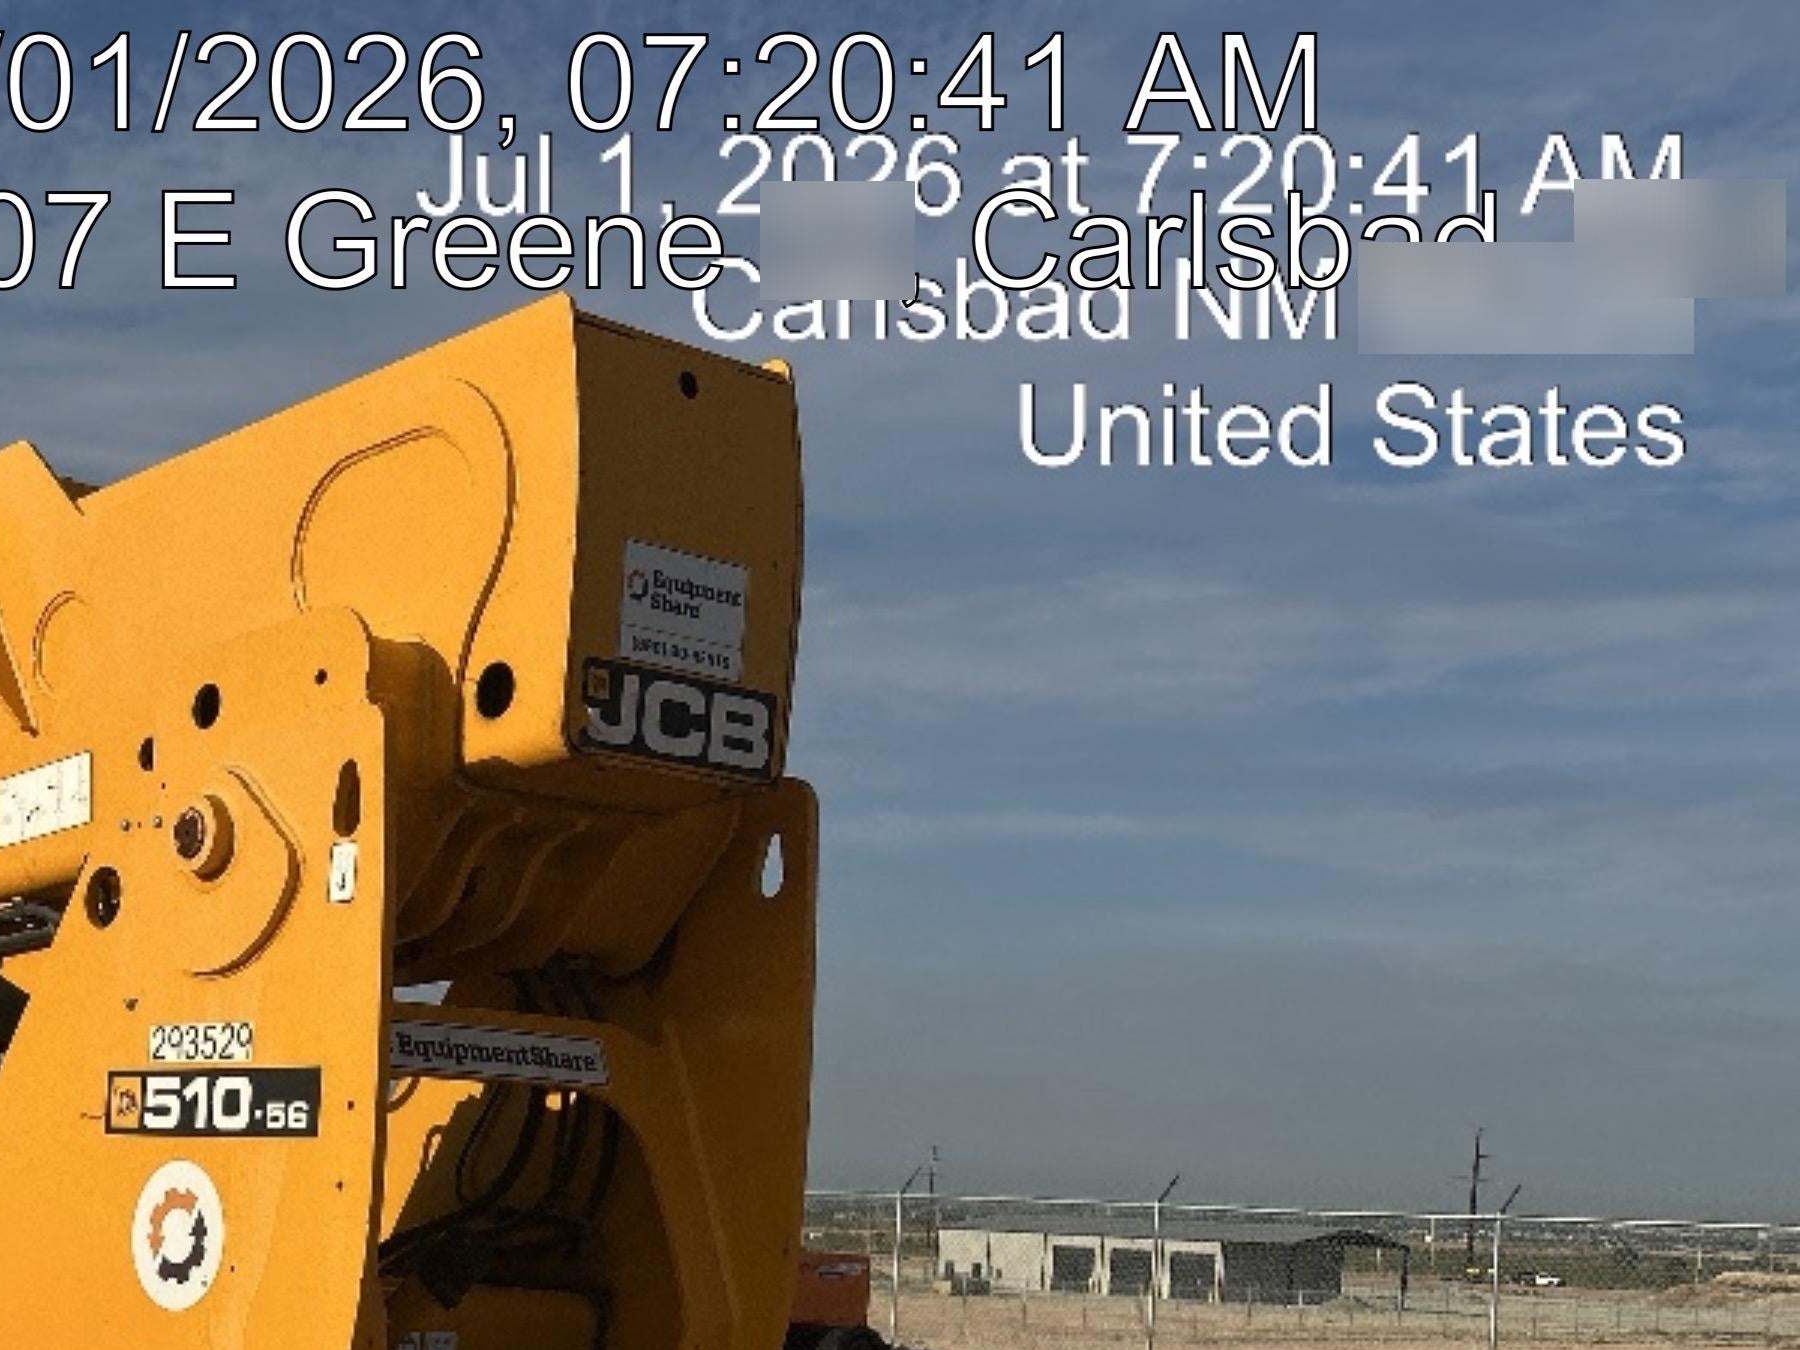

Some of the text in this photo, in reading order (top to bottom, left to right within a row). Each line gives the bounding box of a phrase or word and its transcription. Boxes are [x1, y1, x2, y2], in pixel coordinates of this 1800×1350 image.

[585, 673, 771, 769] JCB
[152, 1021, 253, 1060] 293529
[396, 1031, 598, 1073] EquipmentShare
